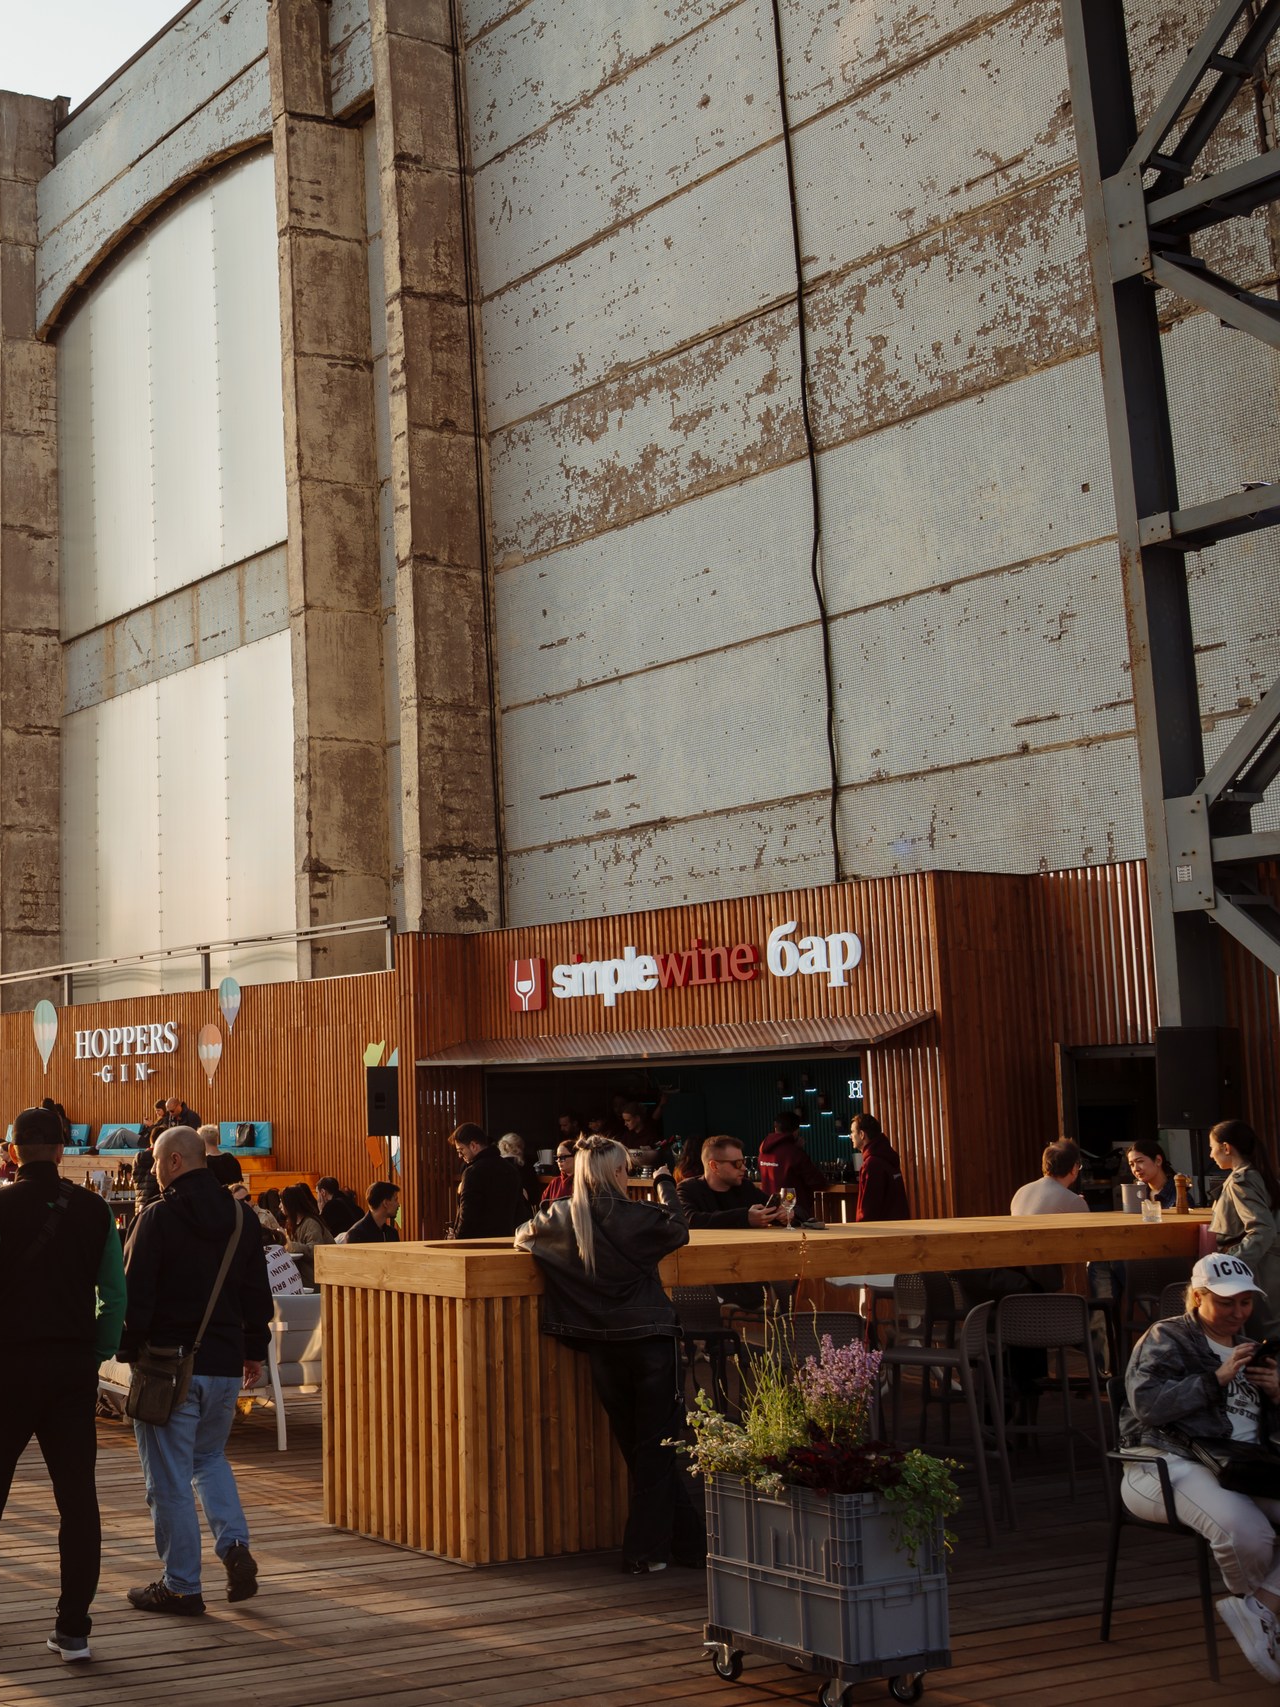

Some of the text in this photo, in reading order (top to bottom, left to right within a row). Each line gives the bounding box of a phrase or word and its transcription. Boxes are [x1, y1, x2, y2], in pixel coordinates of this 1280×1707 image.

[767, 920, 861, 987] бар
[74, 1021, 179, 1059] HOPPERS
[1213, 1260, 1252, 1277] ICON
